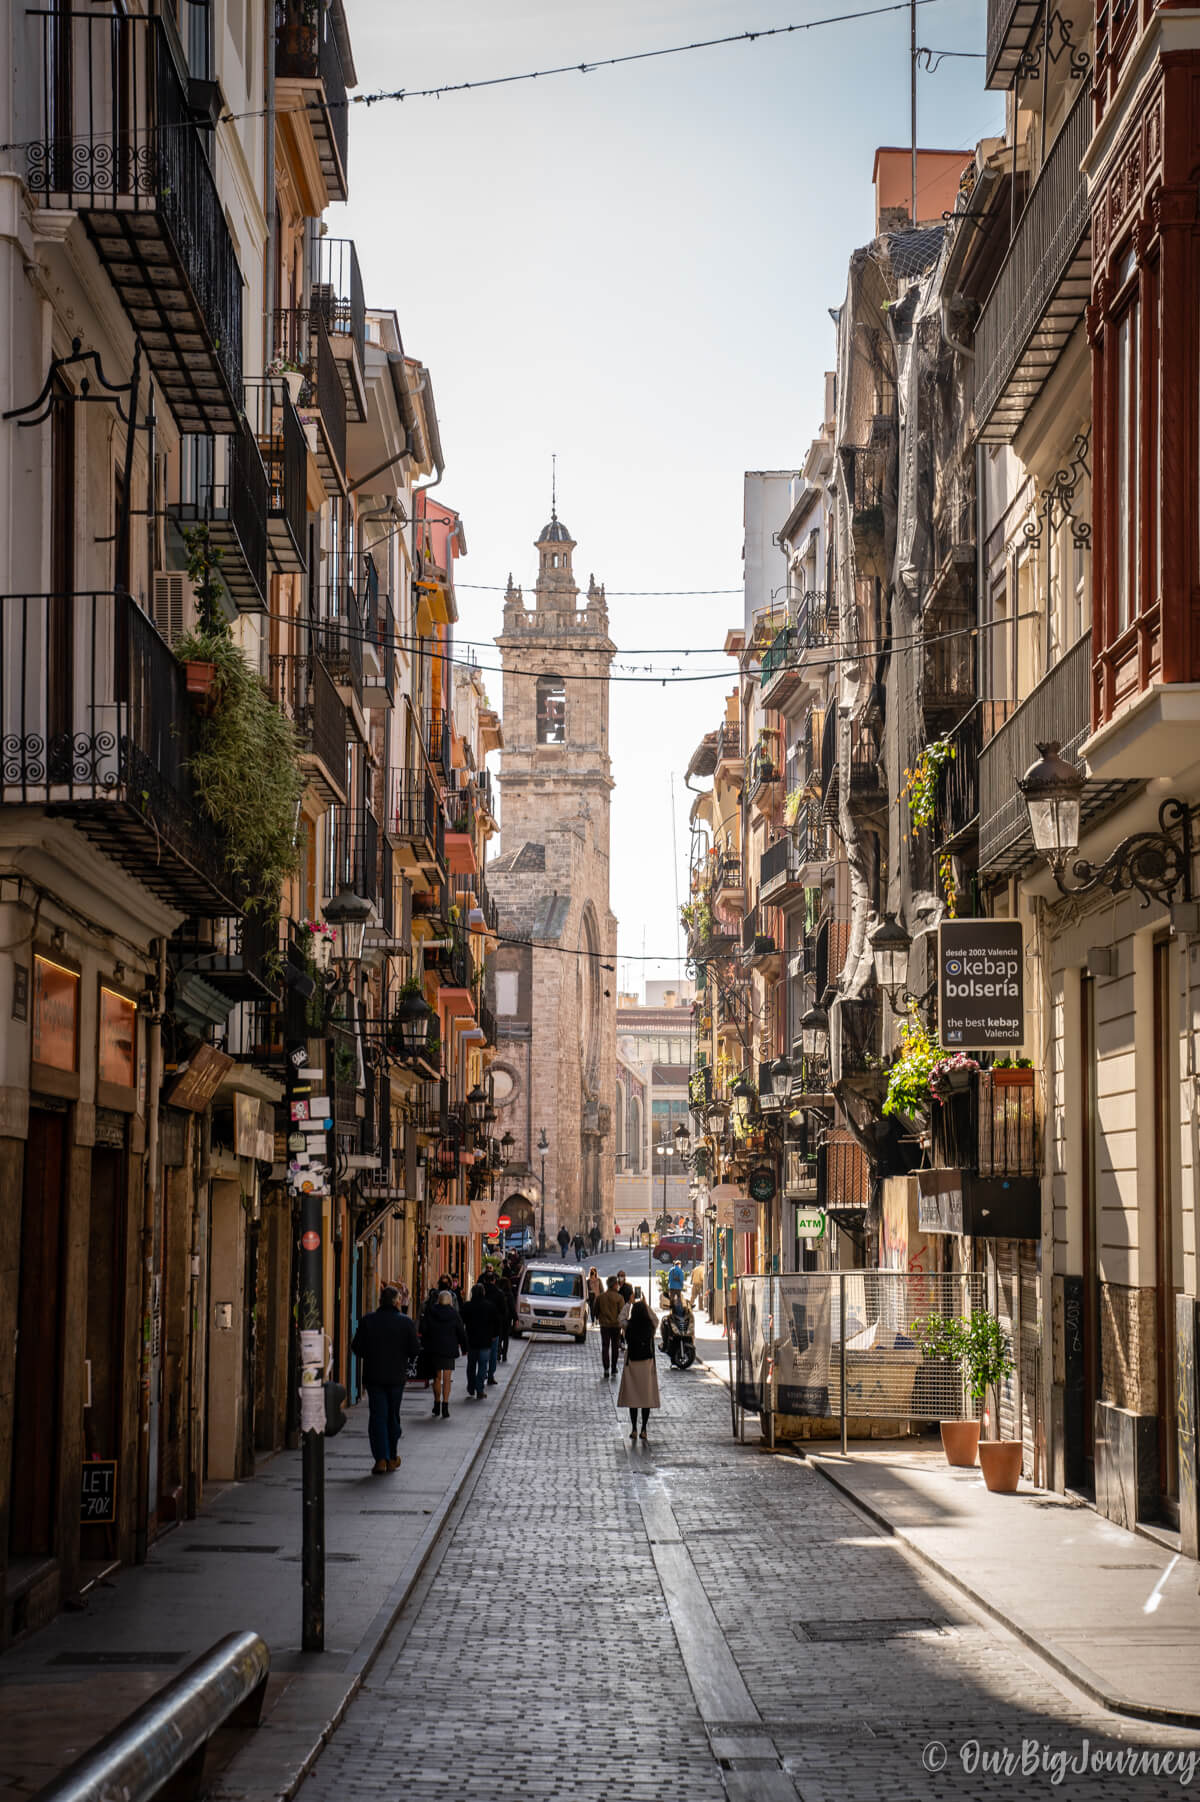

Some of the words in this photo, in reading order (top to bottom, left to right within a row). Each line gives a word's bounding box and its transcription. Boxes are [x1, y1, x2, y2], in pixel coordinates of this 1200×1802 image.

[945, 949, 967, 957] desde
[968, 949, 986, 957] 2002
[988, 948, 1018, 956] Valencia
[963, 957, 1018, 978] kebap
[946, 978, 1019, 997] bolsería
[947, 1018, 963, 1027] the
[965, 1017, 985, 1027] best
[987, 1017, 1019, 1028] kebap
[985, 1028, 1019, 1037] Valencia
[799, 1219, 822, 1228] ATM
[82, 1470, 113, 1493] LET
